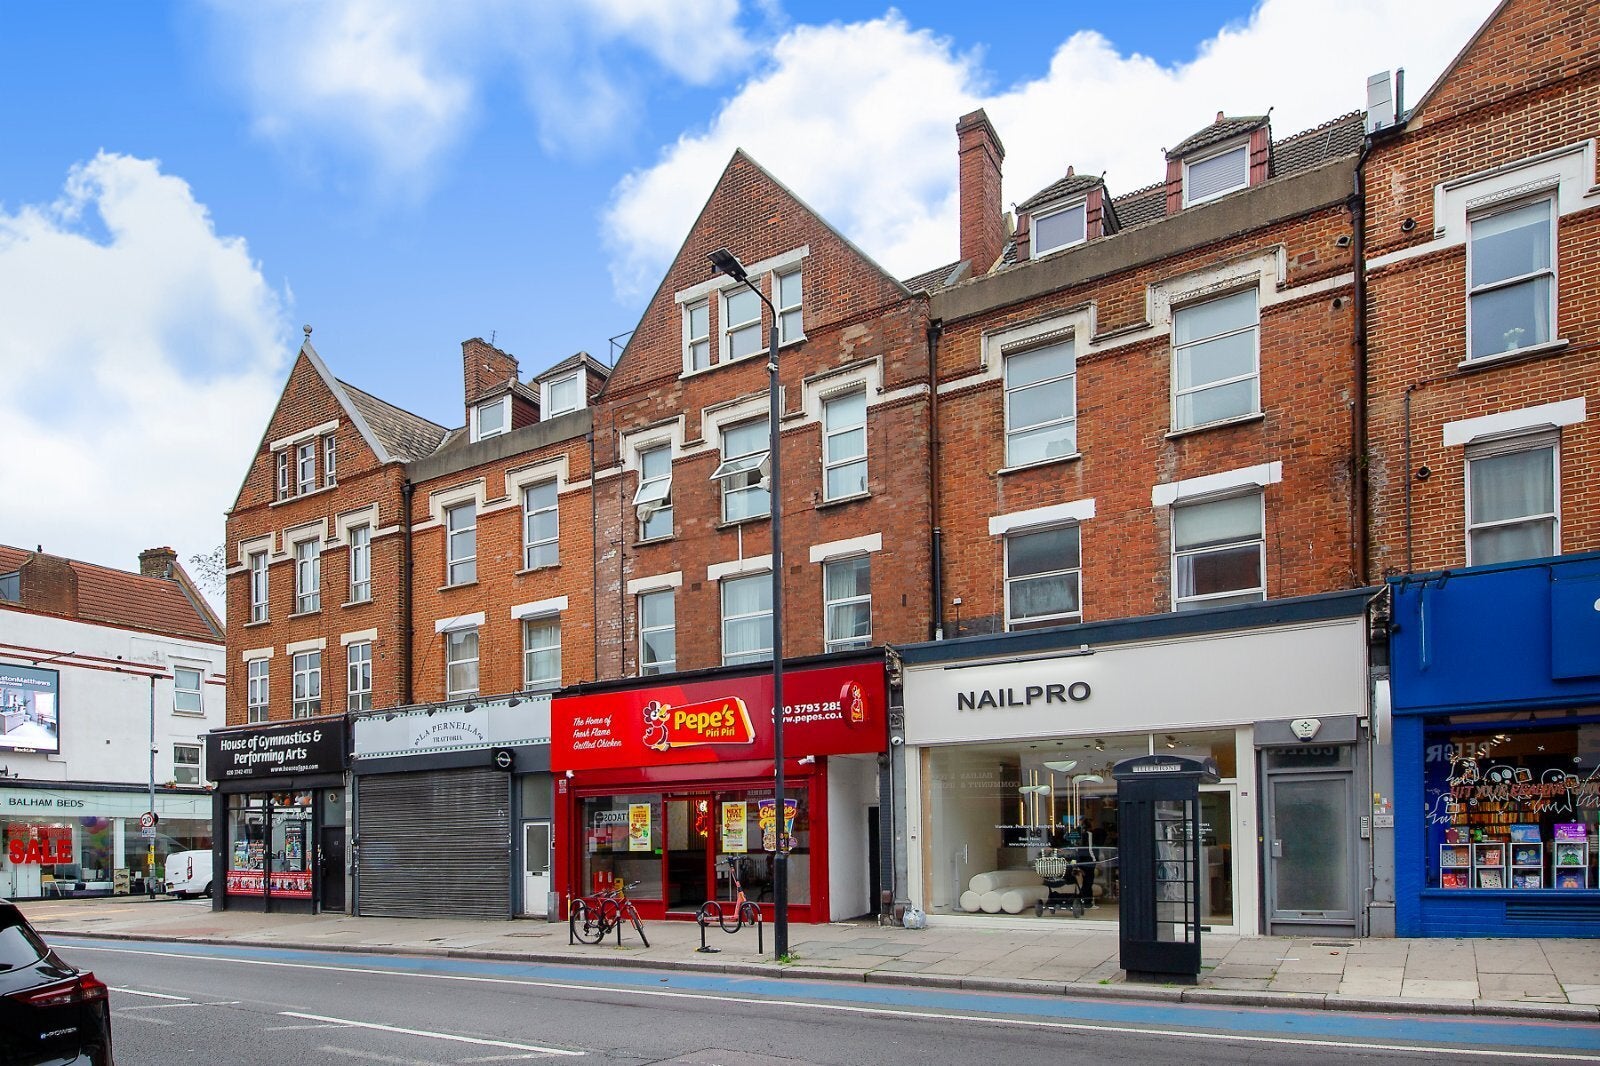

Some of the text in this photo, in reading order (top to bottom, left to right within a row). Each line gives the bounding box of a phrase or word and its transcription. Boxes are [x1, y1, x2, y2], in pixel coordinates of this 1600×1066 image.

[958, 681, 1092, 710] NAILPRO
[794, 703, 820, 714] 3793
[573, 714, 612, 727] The Home of
[674, 704, 735, 734] Pepe's
[419, 721, 479, 741] LA PERNELLA
[573, 727, 611, 738] Fresh Flame
[705, 726, 735, 738] Piri Piri
[220, 730, 322, 751] House of Gymnastics &
[573, 738, 622, 750] Grilled Chicken
[234, 747, 308, 766] Performing Arts
[1450, 785, 1474, 798] HIT
[8, 798, 52, 806] BALHAM
[143, 816, 151, 824] 20
[9, 839, 73, 864] SALE
